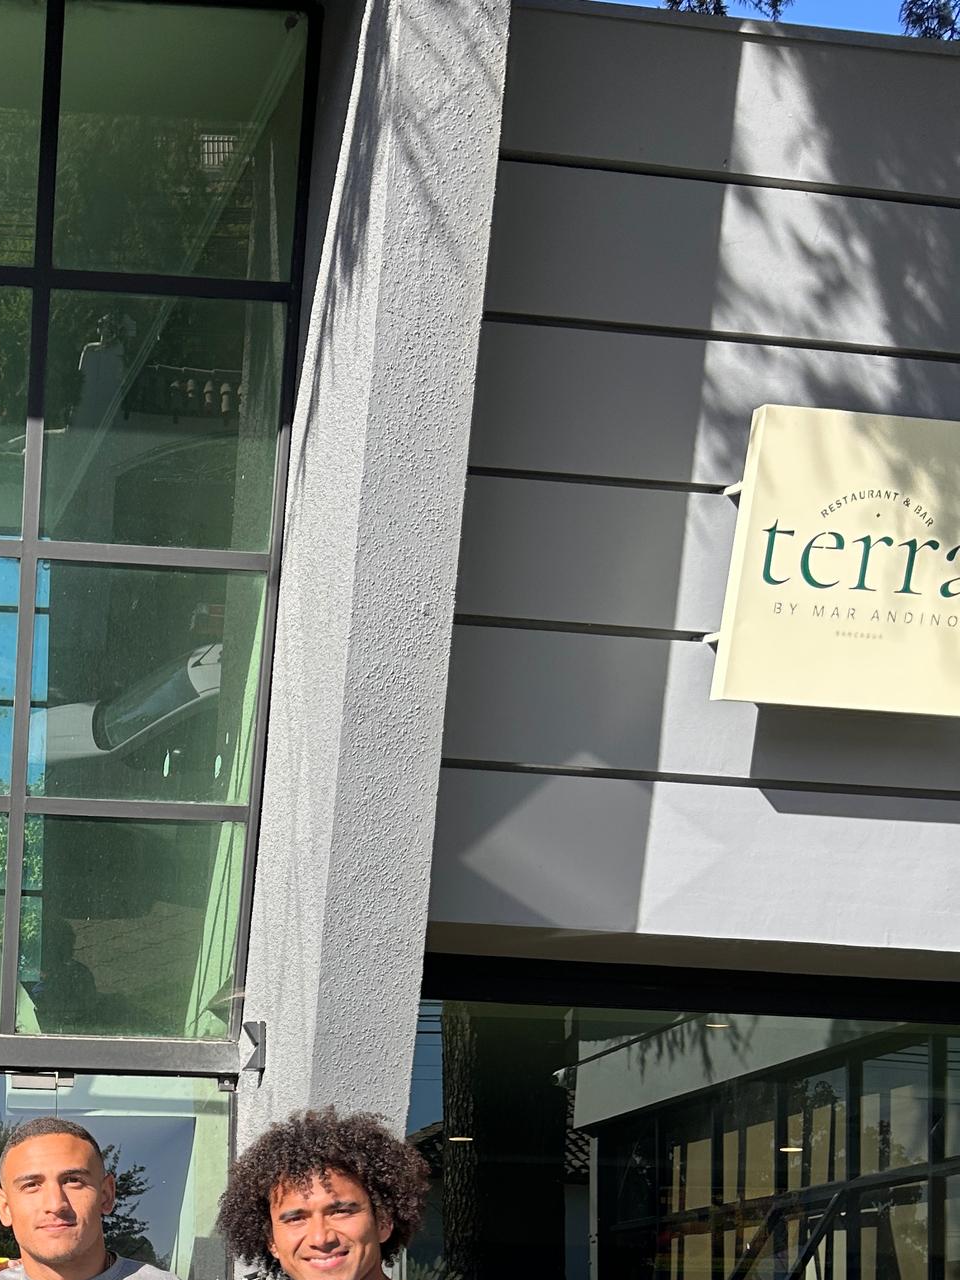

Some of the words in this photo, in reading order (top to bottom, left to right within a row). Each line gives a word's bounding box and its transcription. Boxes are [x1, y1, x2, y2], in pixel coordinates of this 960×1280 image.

[820, 489, 899, 518] RESTAURANT
[903, 497, 911, 508] &
[913, 504, 934, 528] BAR
[773, 602, 798, 615] BY
[812, 604, 856, 620] MAR
[870, 609, 958, 628] ANDINO
